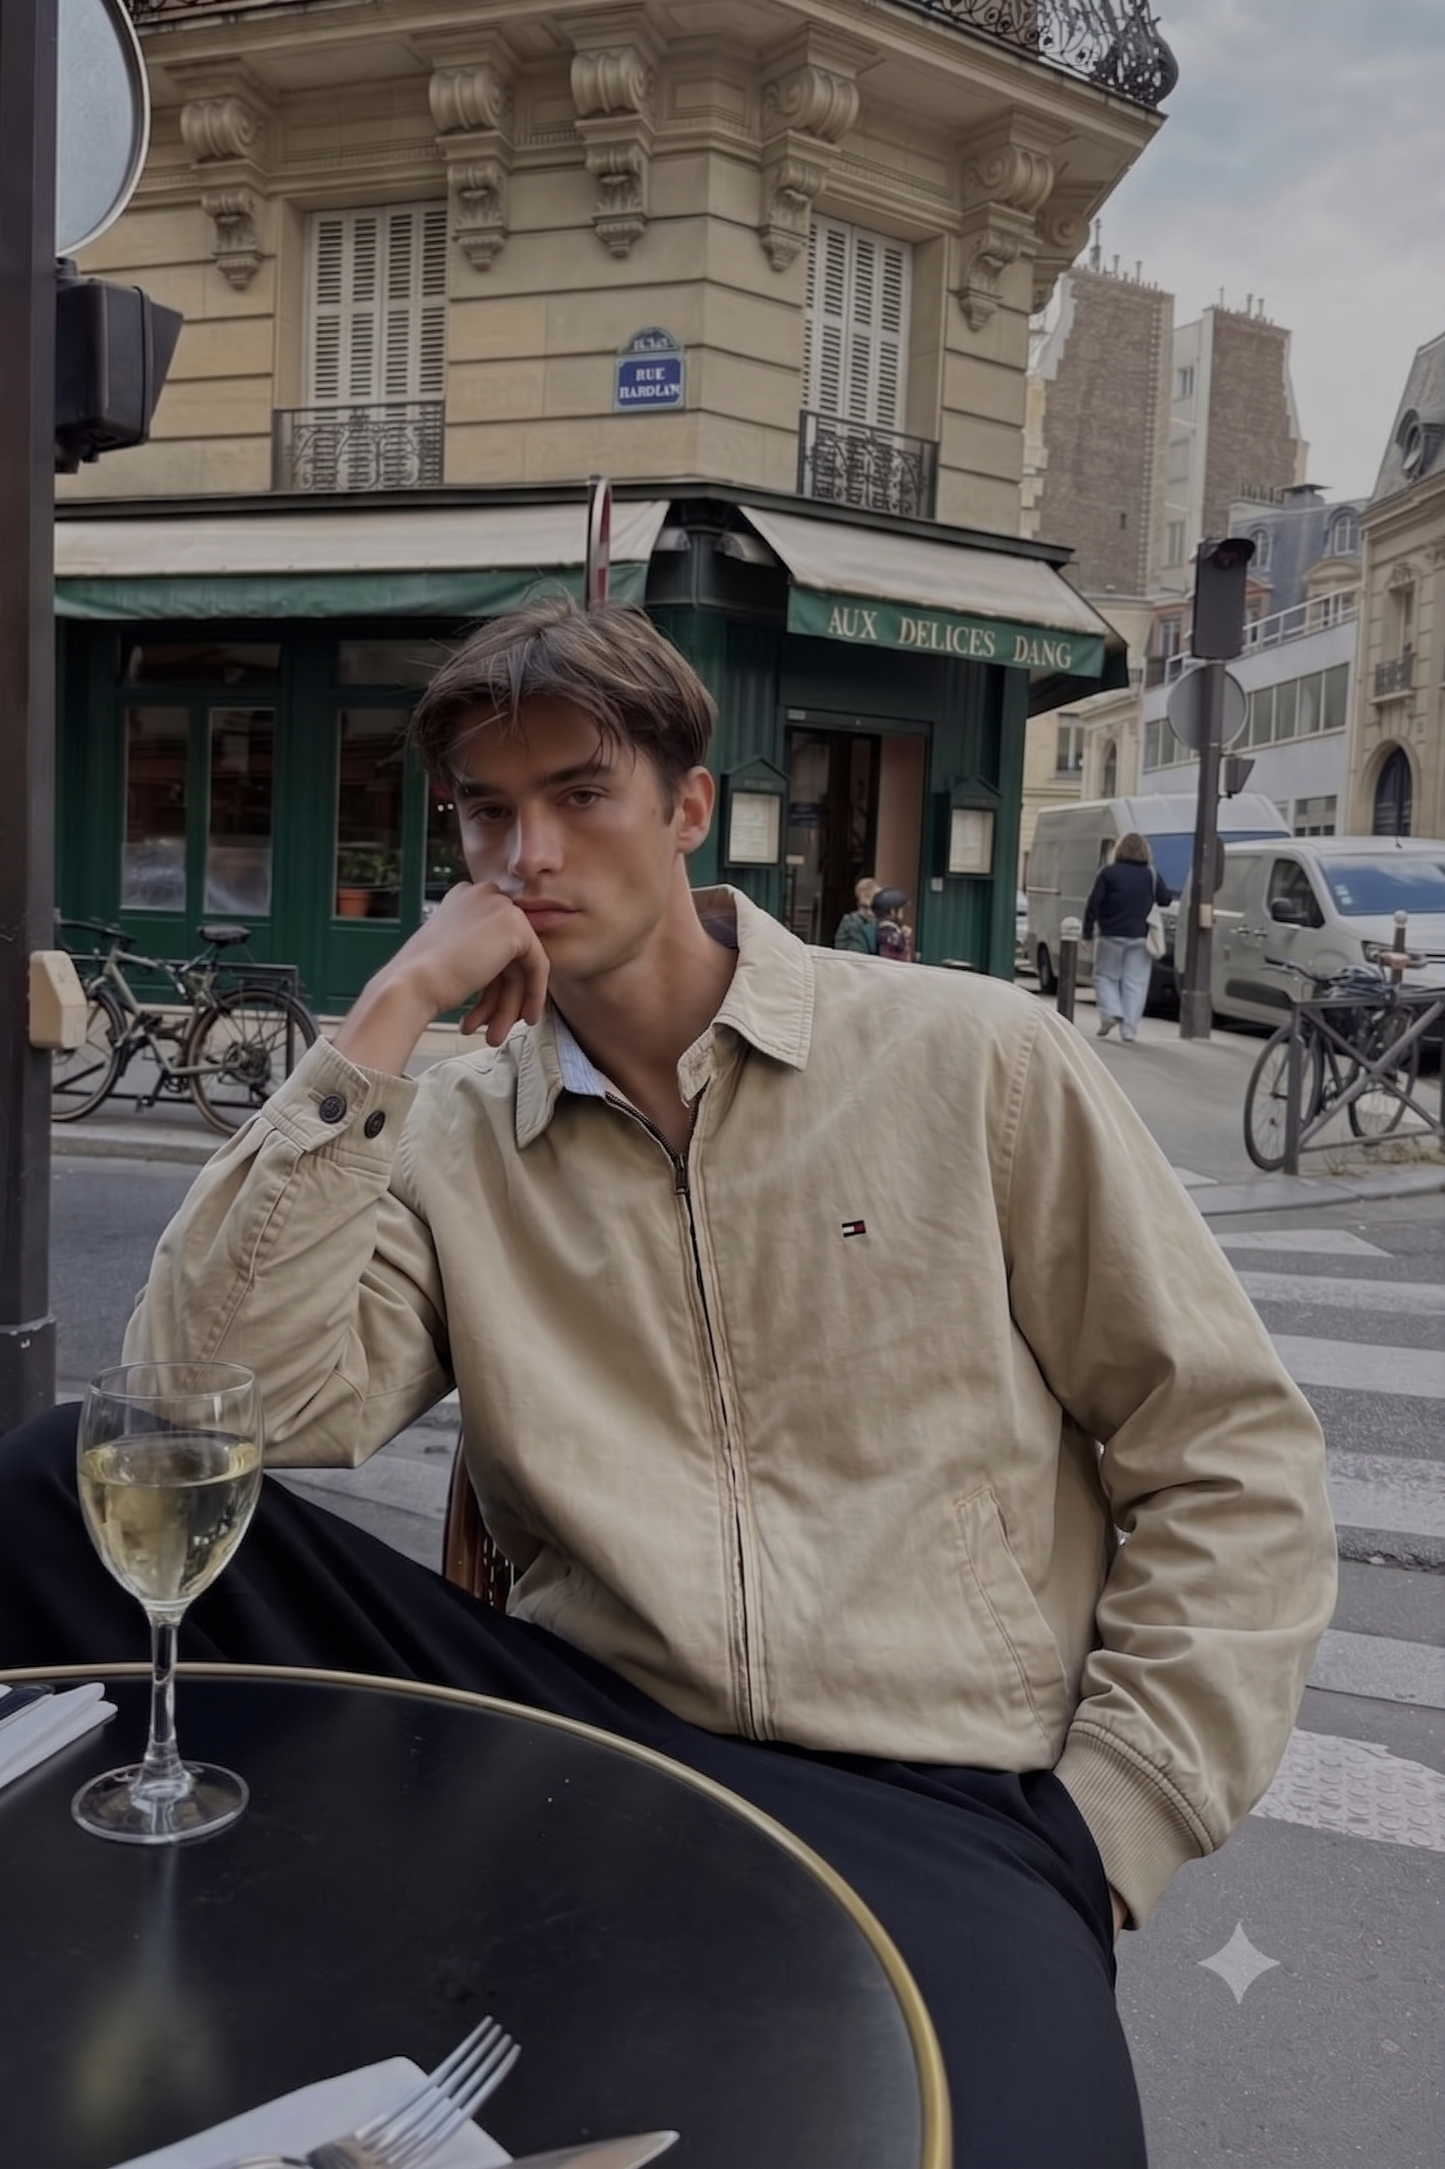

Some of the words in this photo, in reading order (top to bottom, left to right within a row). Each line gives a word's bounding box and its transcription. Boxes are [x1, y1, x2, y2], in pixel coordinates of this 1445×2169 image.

[635, 367, 666, 382] RUE
[828, 605, 878, 640] AUX
[898, 616, 995, 658] DELICES
[1013, 635, 1072, 669] DANG
